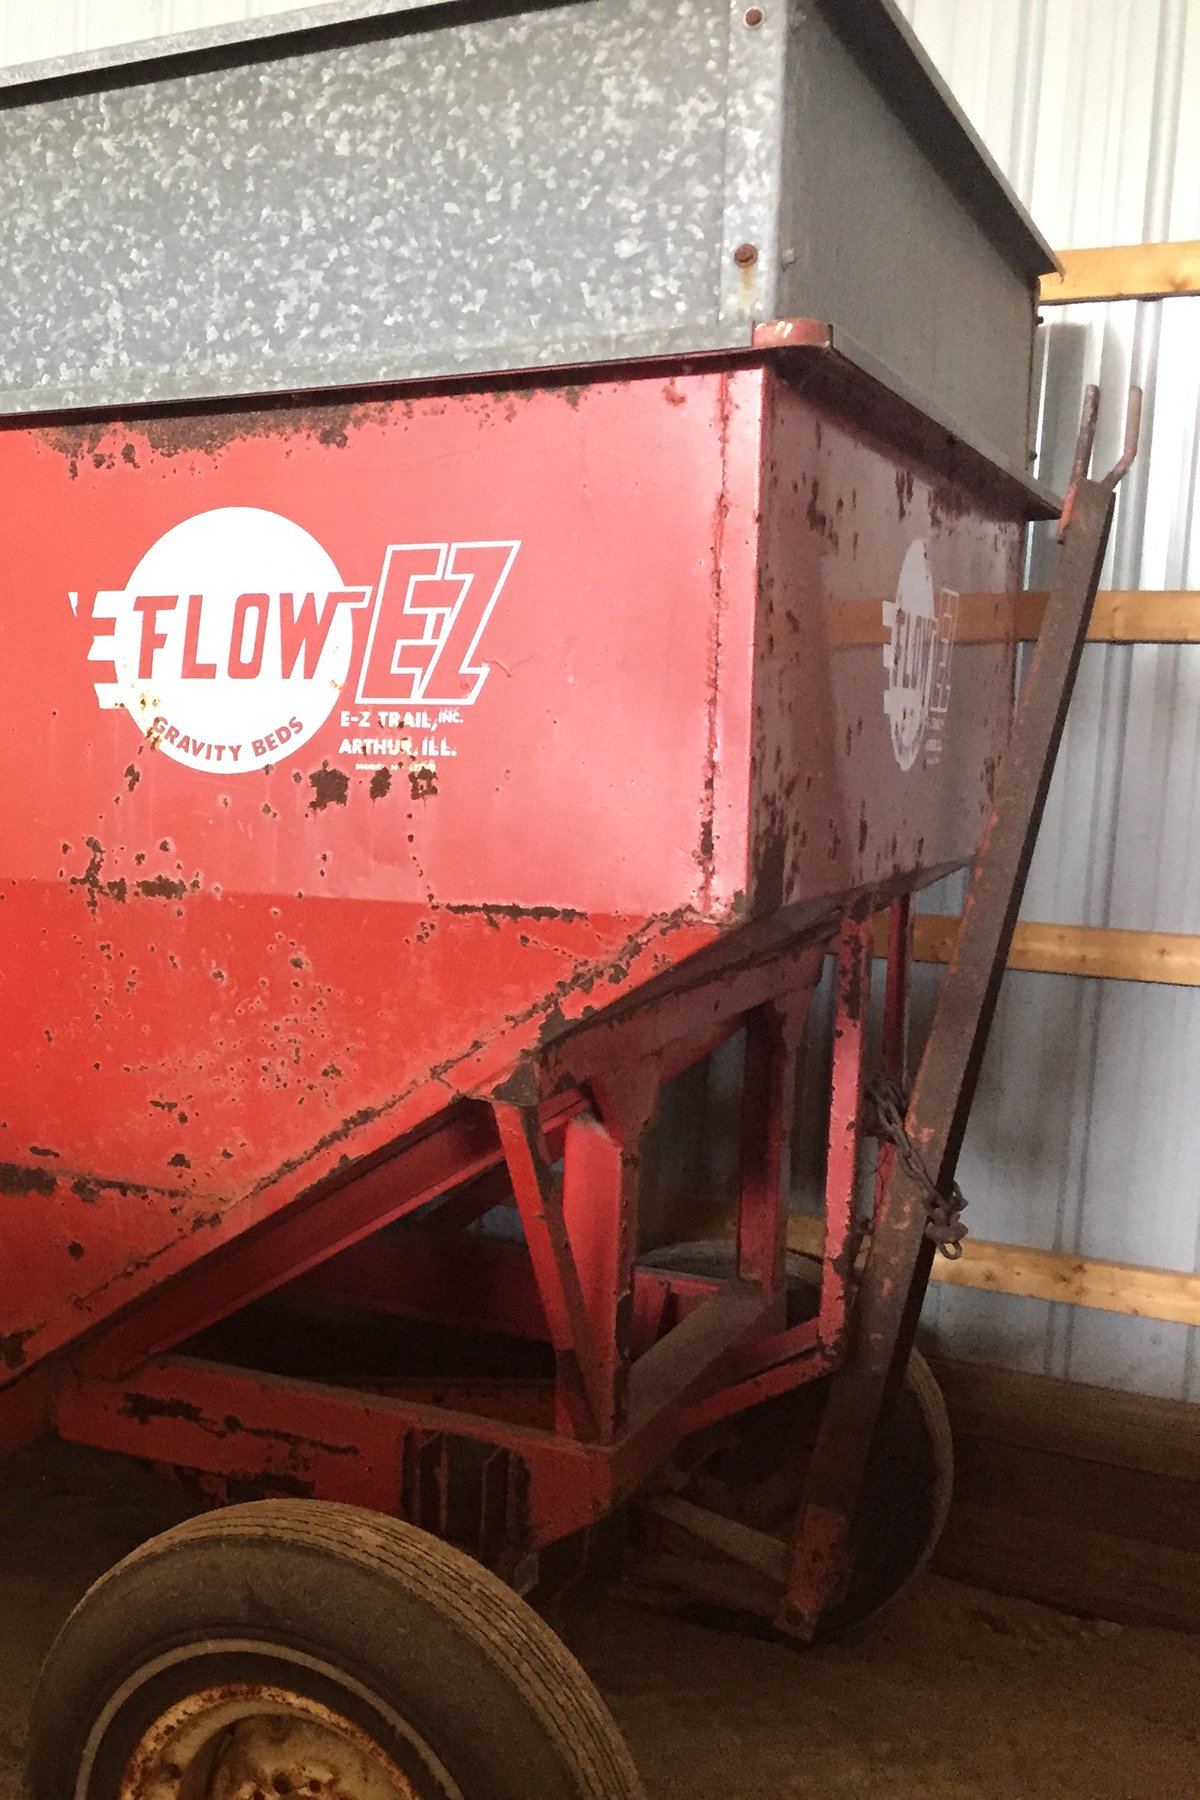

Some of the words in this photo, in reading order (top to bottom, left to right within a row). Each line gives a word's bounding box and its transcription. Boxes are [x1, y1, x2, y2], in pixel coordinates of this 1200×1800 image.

[132, 590, 367, 680] FLOW
[355, 540, 522, 705] EZ
[340, 710, 371, 728] E-Z
[377, 711, 438, 732] TRAIL,
[438, 708, 464, 723] INC.
[152, 716, 242, 762] GRAVITY
[251, 716, 304, 758] BEDS
[338, 737, 418, 756] ARTHUR,
[421, 736, 457, 756] ILL.
